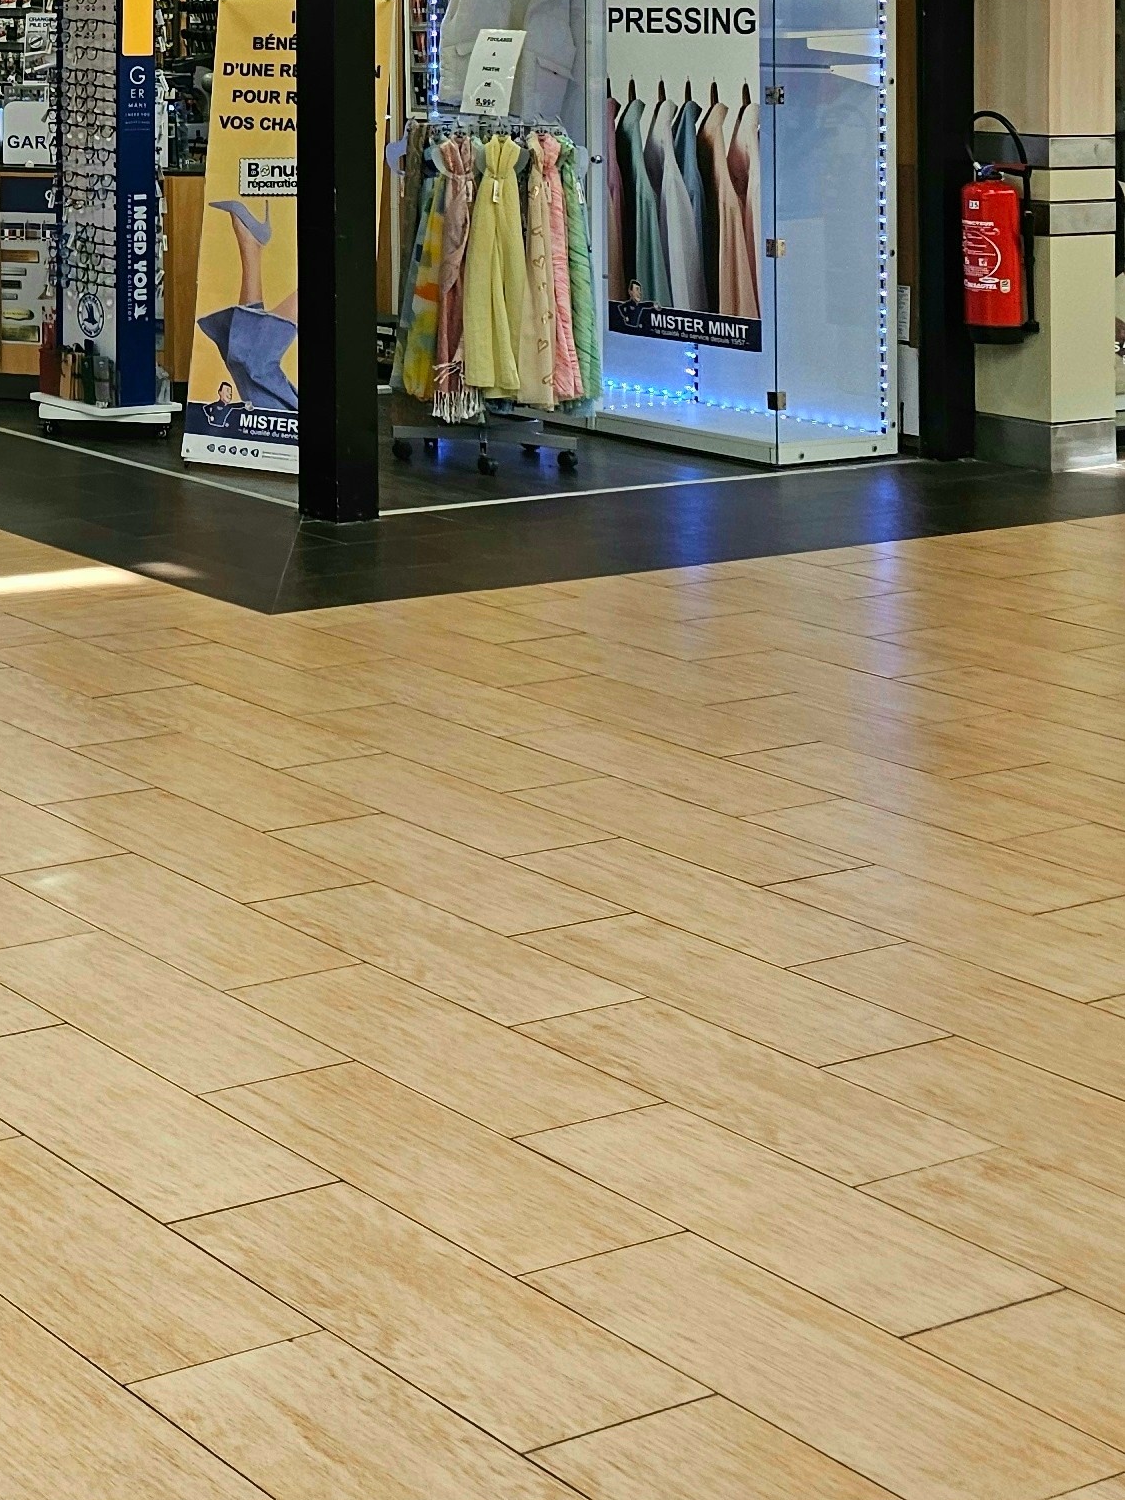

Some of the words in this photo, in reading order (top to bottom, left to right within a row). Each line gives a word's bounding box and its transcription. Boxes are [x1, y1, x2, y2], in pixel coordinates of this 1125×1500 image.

[608, 7, 756, 35] PRESSING
[129, 65, 146, 85] G
[223, 63, 275, 77] D'UNE
[130, 88, 145, 99] ER
[232, 90, 281, 105] POUR
[219, 115, 254, 130] VOS
[133, 205, 147, 255] NEED
[133, 260, 148, 301] YOU
[650, 313, 705, 334] MISTER
[708, 320, 749, 339] MINIT
[239, 413, 299, 433] MISTER
[249, 428, 270, 437] qualité
[272, 430, 280, 438] du
